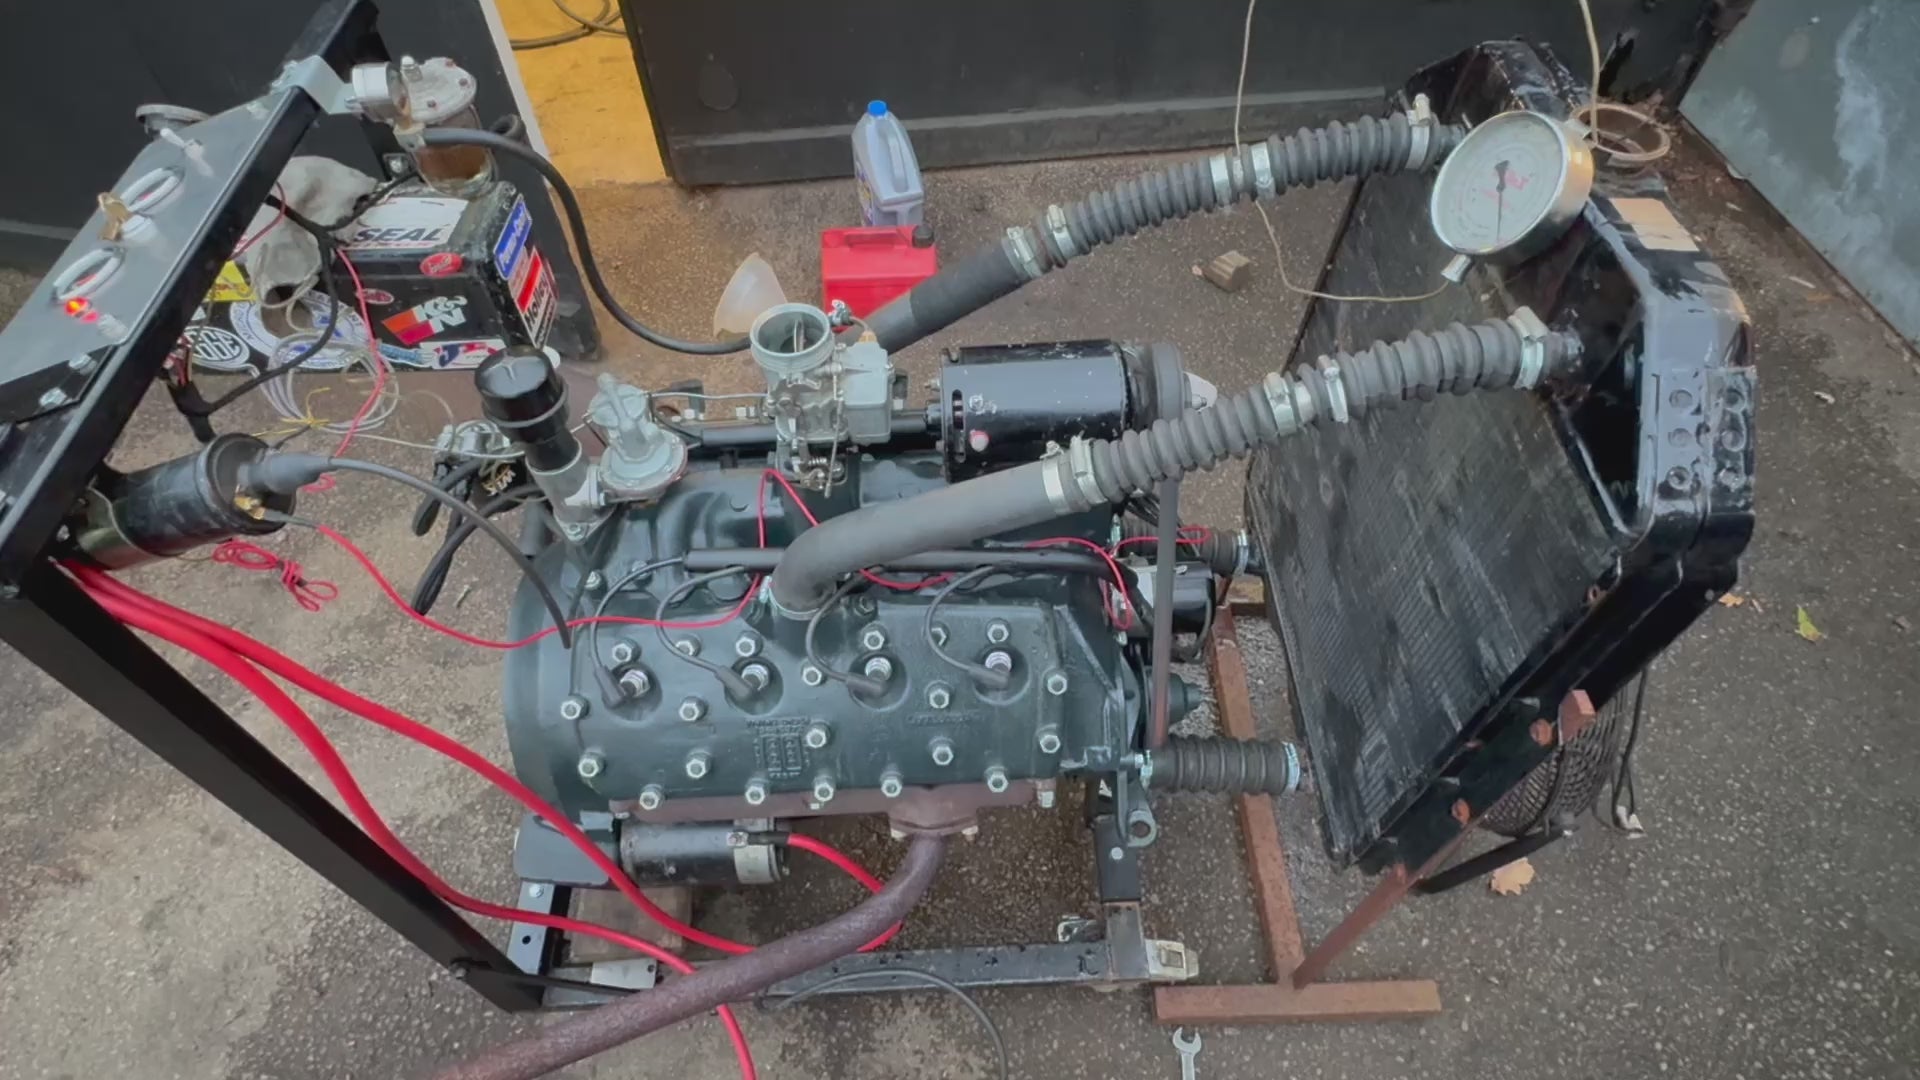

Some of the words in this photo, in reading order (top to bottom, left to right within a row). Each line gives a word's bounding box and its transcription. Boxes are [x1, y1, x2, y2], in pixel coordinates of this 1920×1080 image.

[353, 227, 444, 242] SEAL
[412, 295, 468, 334] K&N
[523, 270, 549, 332] Holley
